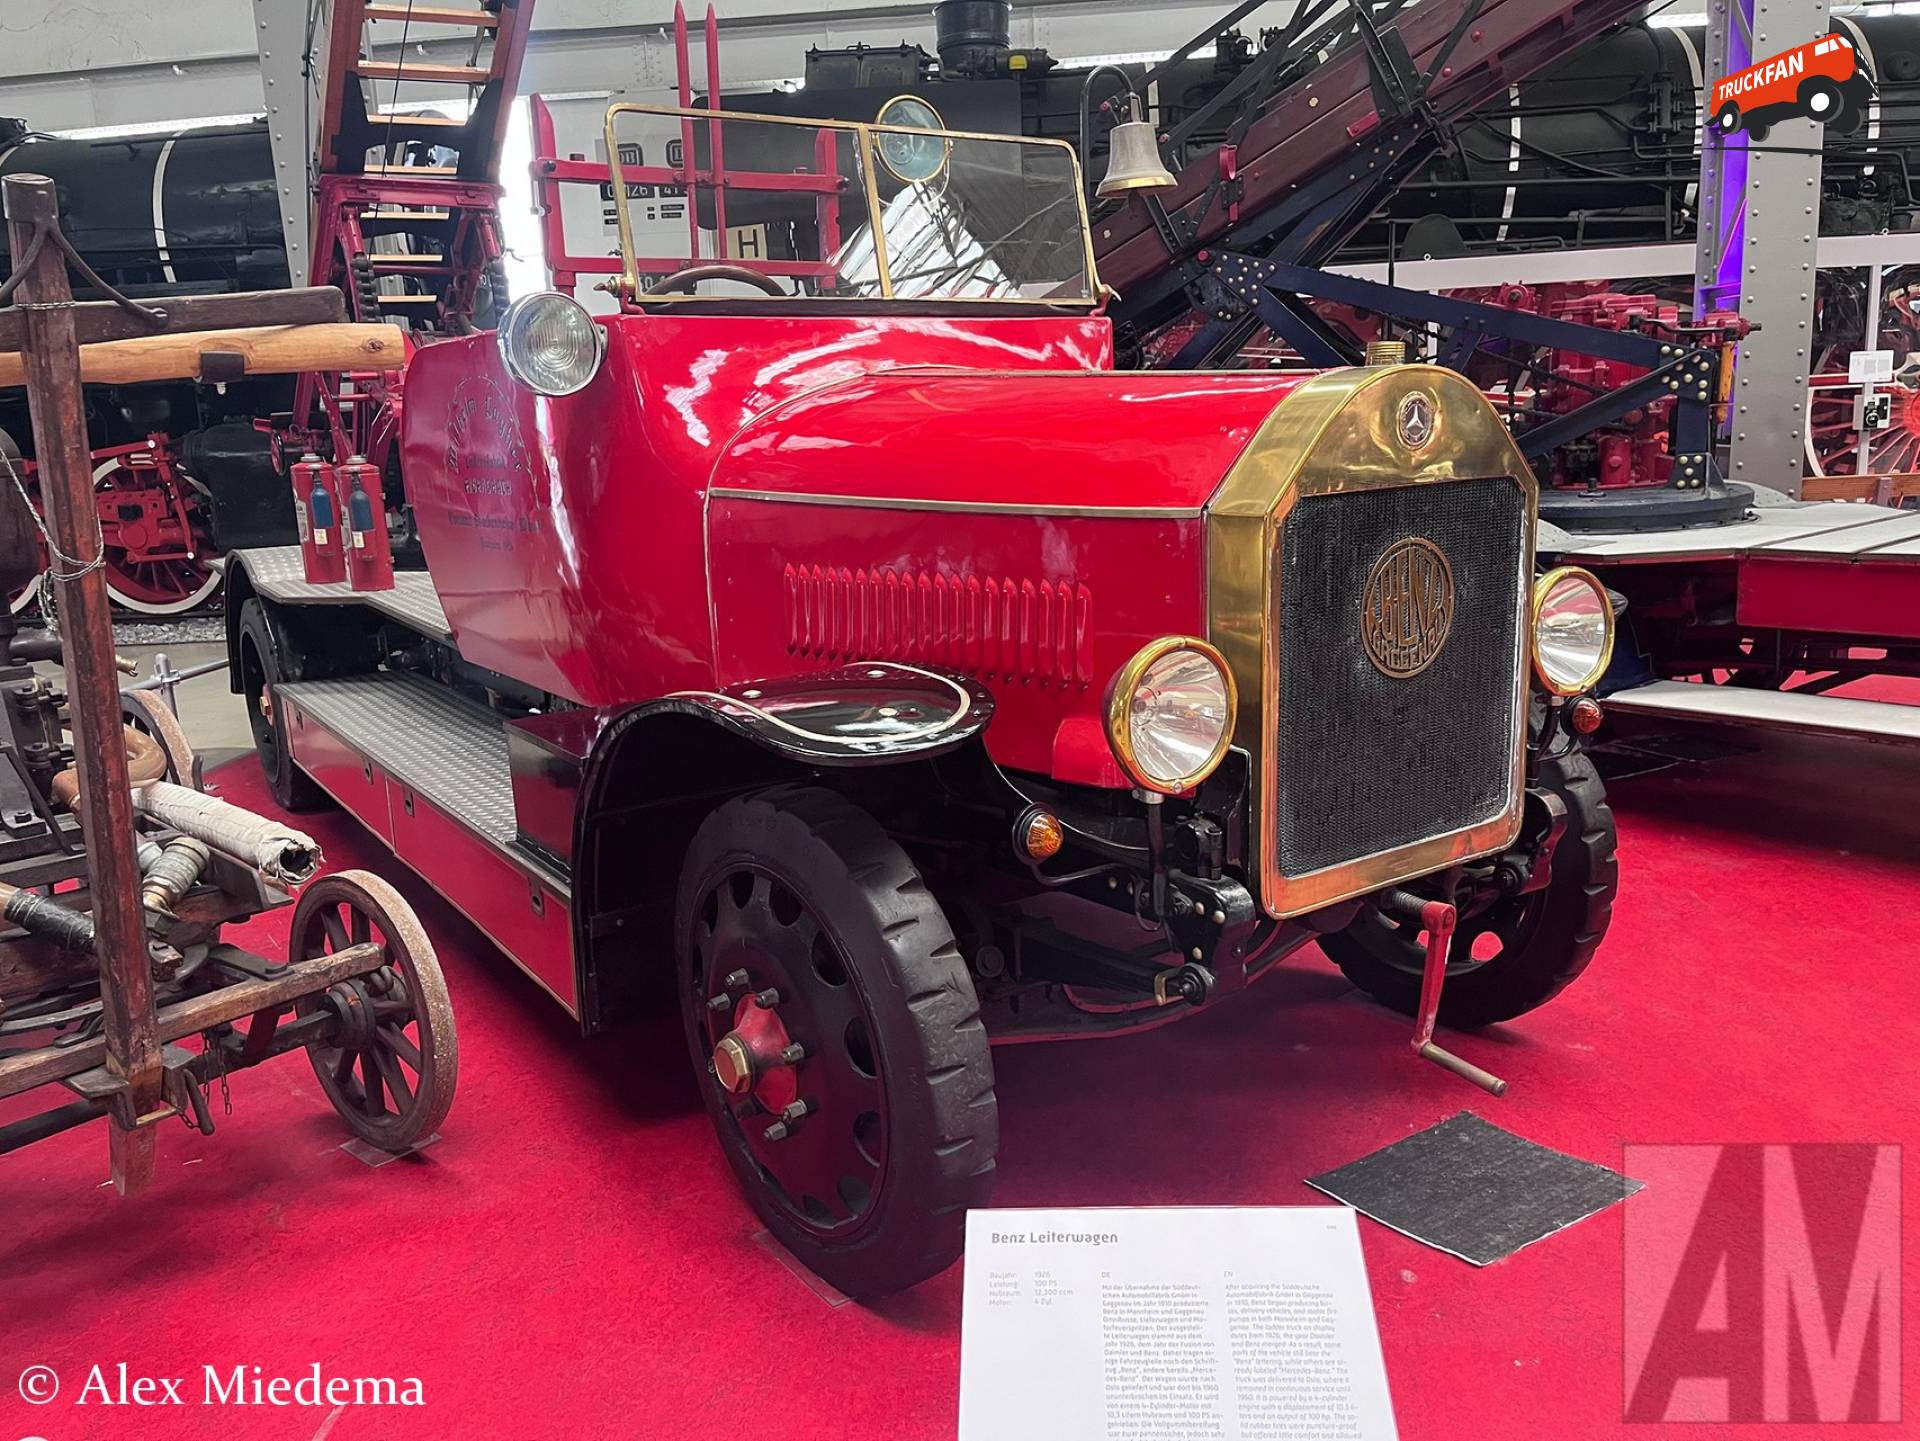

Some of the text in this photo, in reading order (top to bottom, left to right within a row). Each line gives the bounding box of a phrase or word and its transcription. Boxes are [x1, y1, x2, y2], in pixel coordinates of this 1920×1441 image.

[737, 229, 759, 258] H
[1372, 546, 1447, 646] BENZ
[991, 1230, 1119, 1246] Benz Leiterwagen
